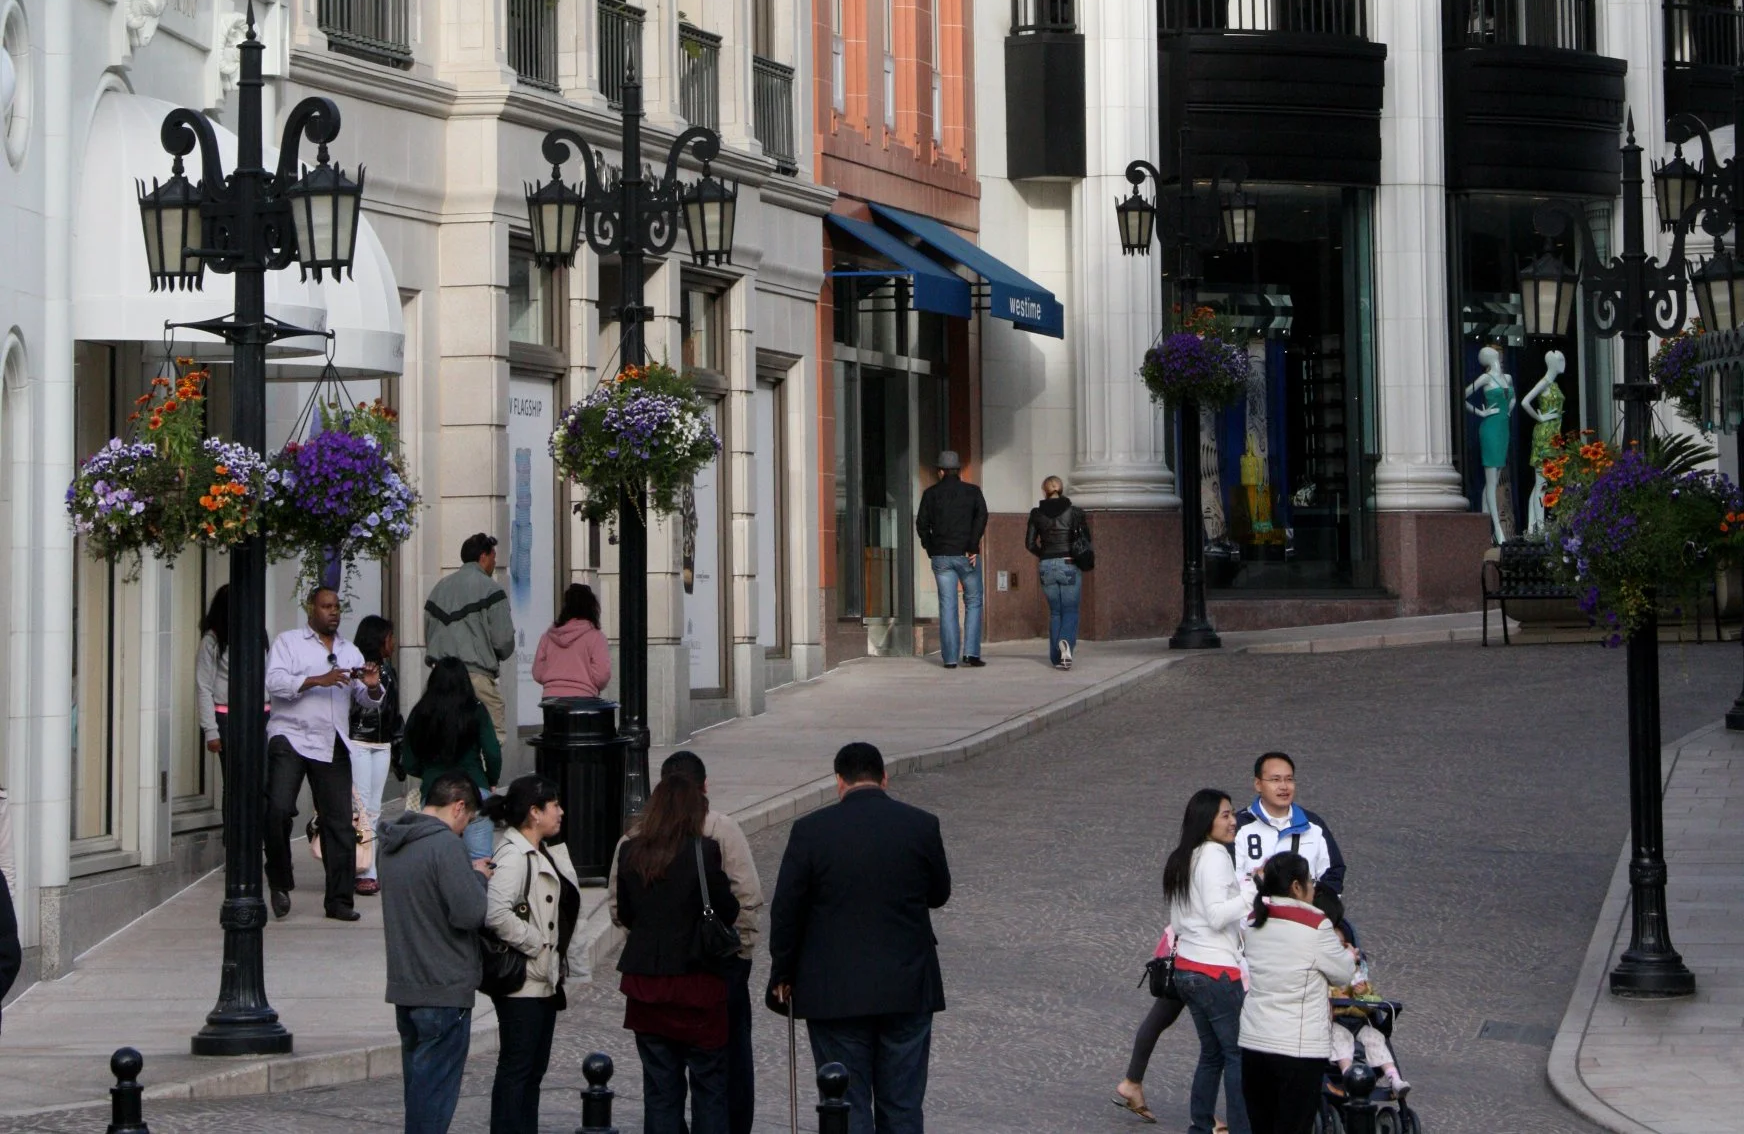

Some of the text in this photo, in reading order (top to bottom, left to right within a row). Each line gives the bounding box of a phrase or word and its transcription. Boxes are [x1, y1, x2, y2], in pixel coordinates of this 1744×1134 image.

[1009, 296, 1041, 320] westime
[514, 397, 543, 418] FLAGSHIP
[1247, 833, 1263, 860] 8
